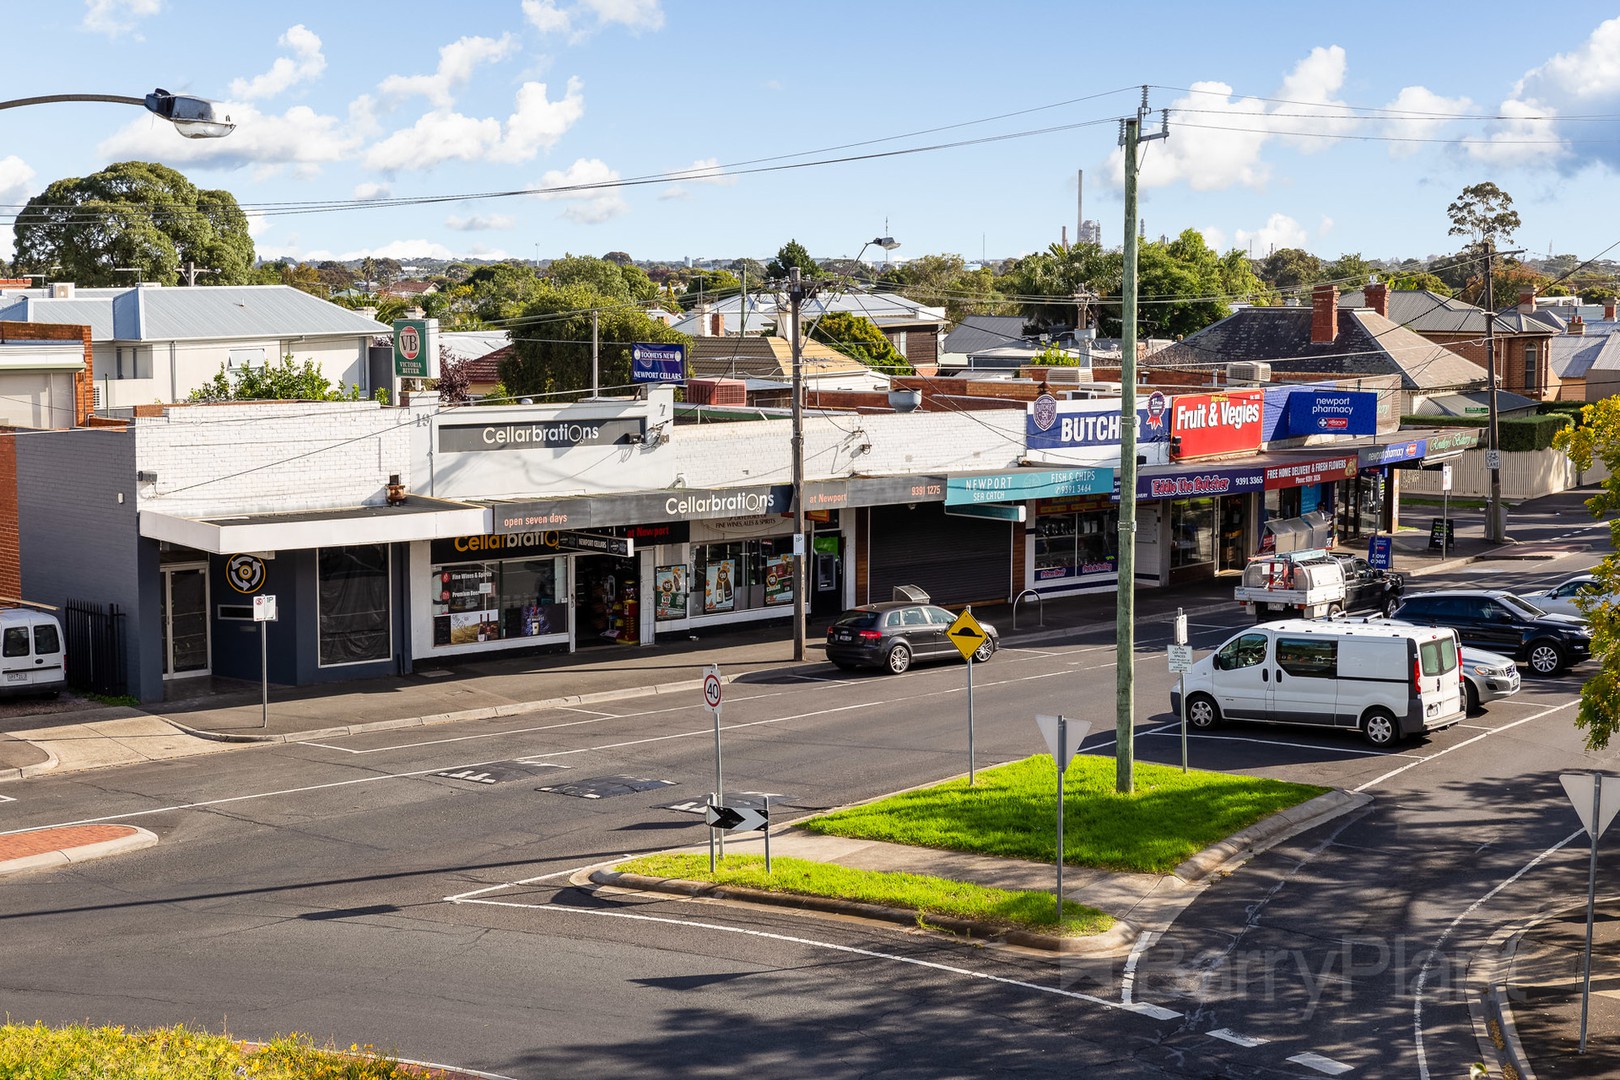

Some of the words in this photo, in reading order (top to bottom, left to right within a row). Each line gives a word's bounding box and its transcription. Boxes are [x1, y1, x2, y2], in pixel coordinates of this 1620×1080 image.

[401, 334, 417, 351] VB
[1316, 398, 1350, 407] newport
[1176, 404, 1206, 430] Fruit
[1208, 402, 1218, 427] &
[1220, 400, 1259, 429] Vegies
[1312, 404, 1354, 414] pharmacy
[1060, 416, 1141, 442] BUTCHR
[1266, 469, 1278, 480] FREE
[1278, 467, 1292, 478] HOME
[1292, 464, 1310, 476] DELIVERY
[1312, 463, 1314, 473] &
[1316, 461, 1328, 472] FRESH
[1328, 459, 1346, 470] FLOWERS
[1051, 474, 1067, 482] FISH
[1069, 472, 1073, 481] &
[1075, 470, 1096, 481] CHIPS
[1235, 478, 1250, 486] 9391
[1250, 476, 1264, 485] 3365
[965, 476, 1012, 492] NEWPORT
[1061, 486, 1076, 495] 9391
[1077, 484, 1092, 494] 3464
[1152, 479, 1177, 497] Eddie
[1194, 475, 1230, 494] Butcher
[912, 486, 926, 496] 9391
[928, 485, 941, 495] 1275
[973, 492, 984, 501] SEA
[986, 490, 1004, 500] CATCH
[810, 496, 817, 504] at
[818, 494, 848, 504] Newport
[504, 517, 523, 527] open
[525, 516, 548, 525] seven
[550, 514, 568, 524] days
[636, 527, 669, 537] Newport
[706, 684, 718, 699] 40
